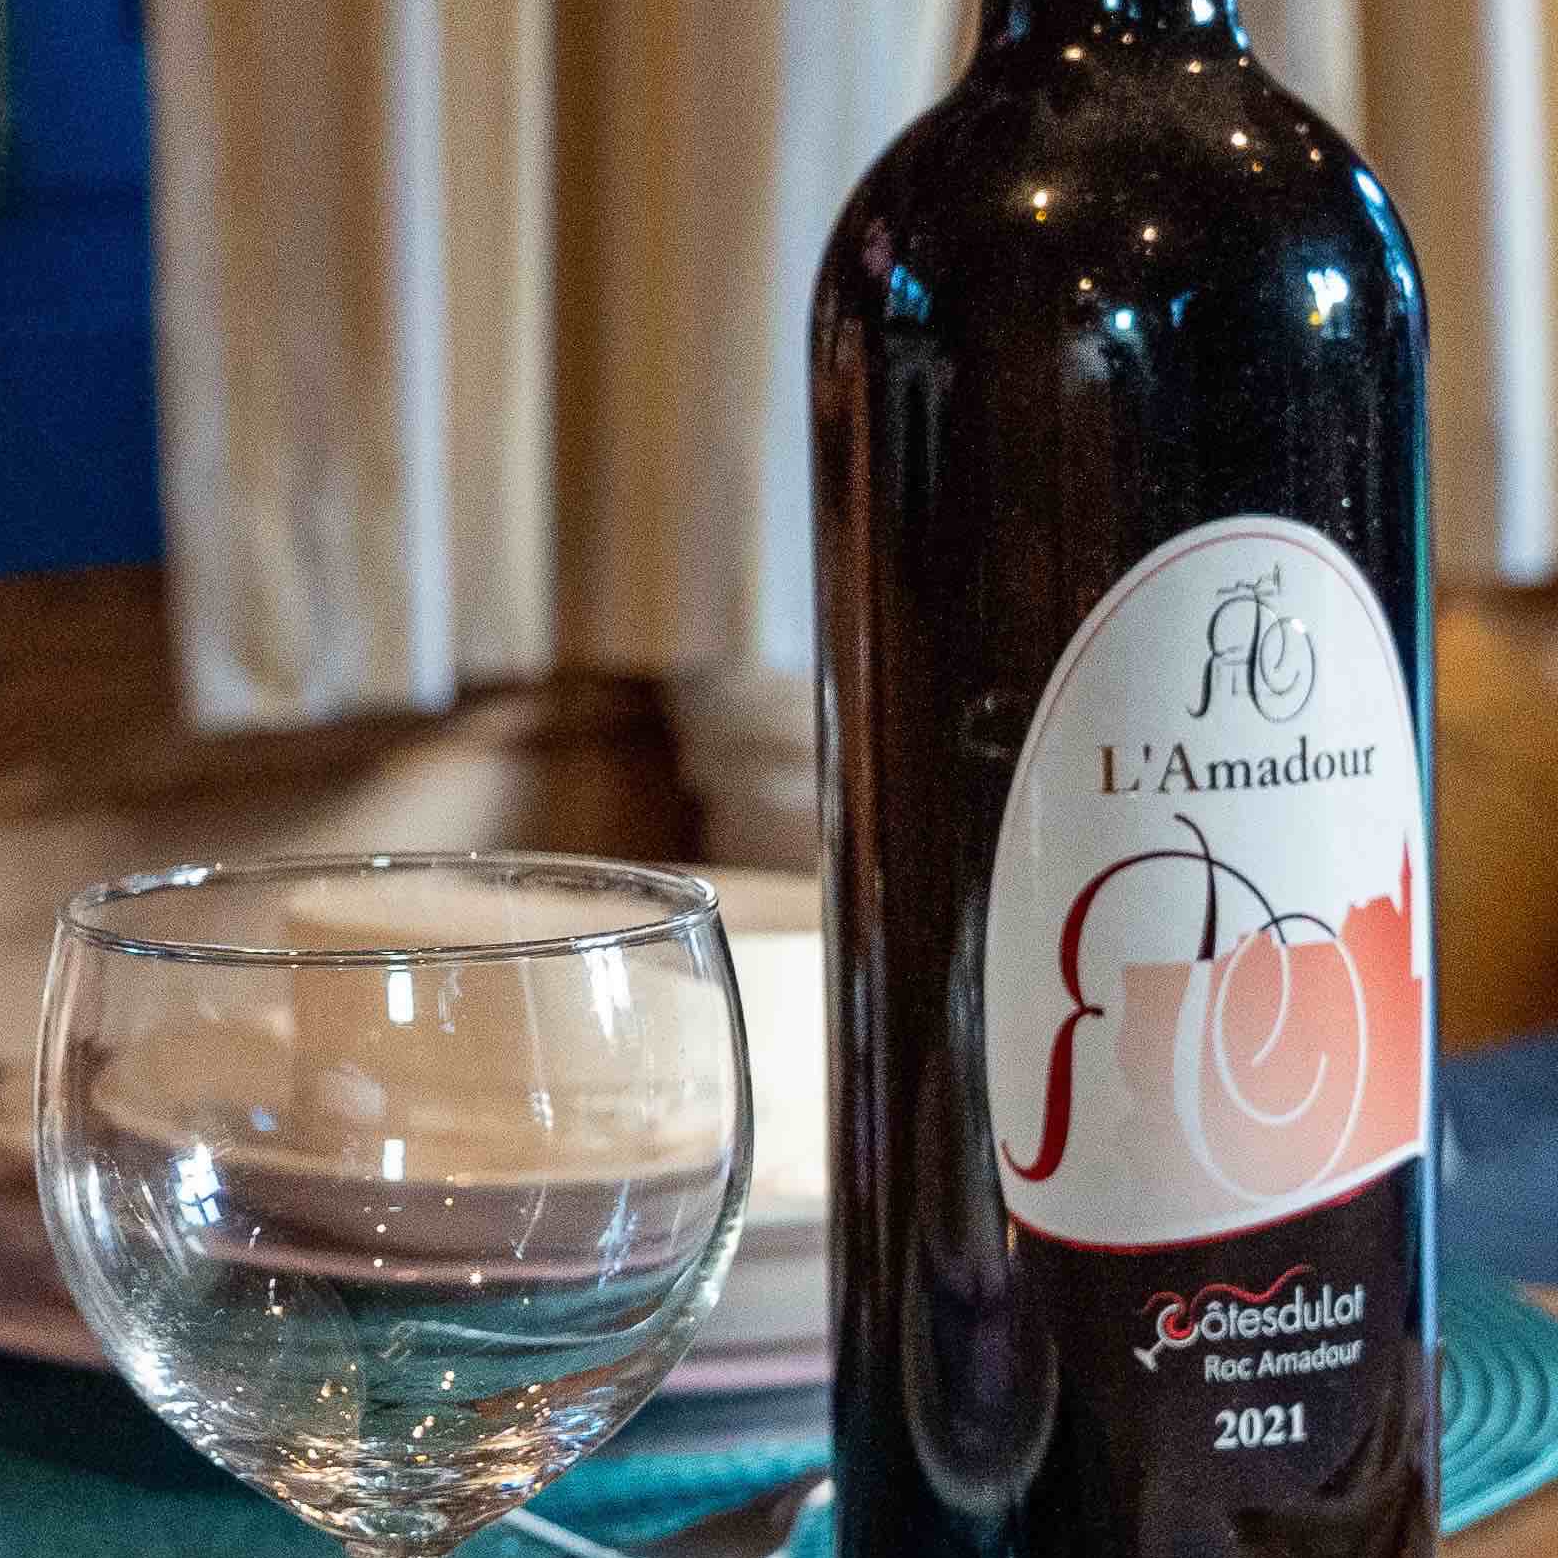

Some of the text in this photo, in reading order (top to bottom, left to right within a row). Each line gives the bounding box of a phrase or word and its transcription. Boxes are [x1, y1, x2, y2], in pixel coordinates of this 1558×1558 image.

[1097, 735, 1376, 794] L'Amadour
[1203, 1339, 1364, 1383] Roc Amadour
[1213, 1401, 1309, 1451] 2021
